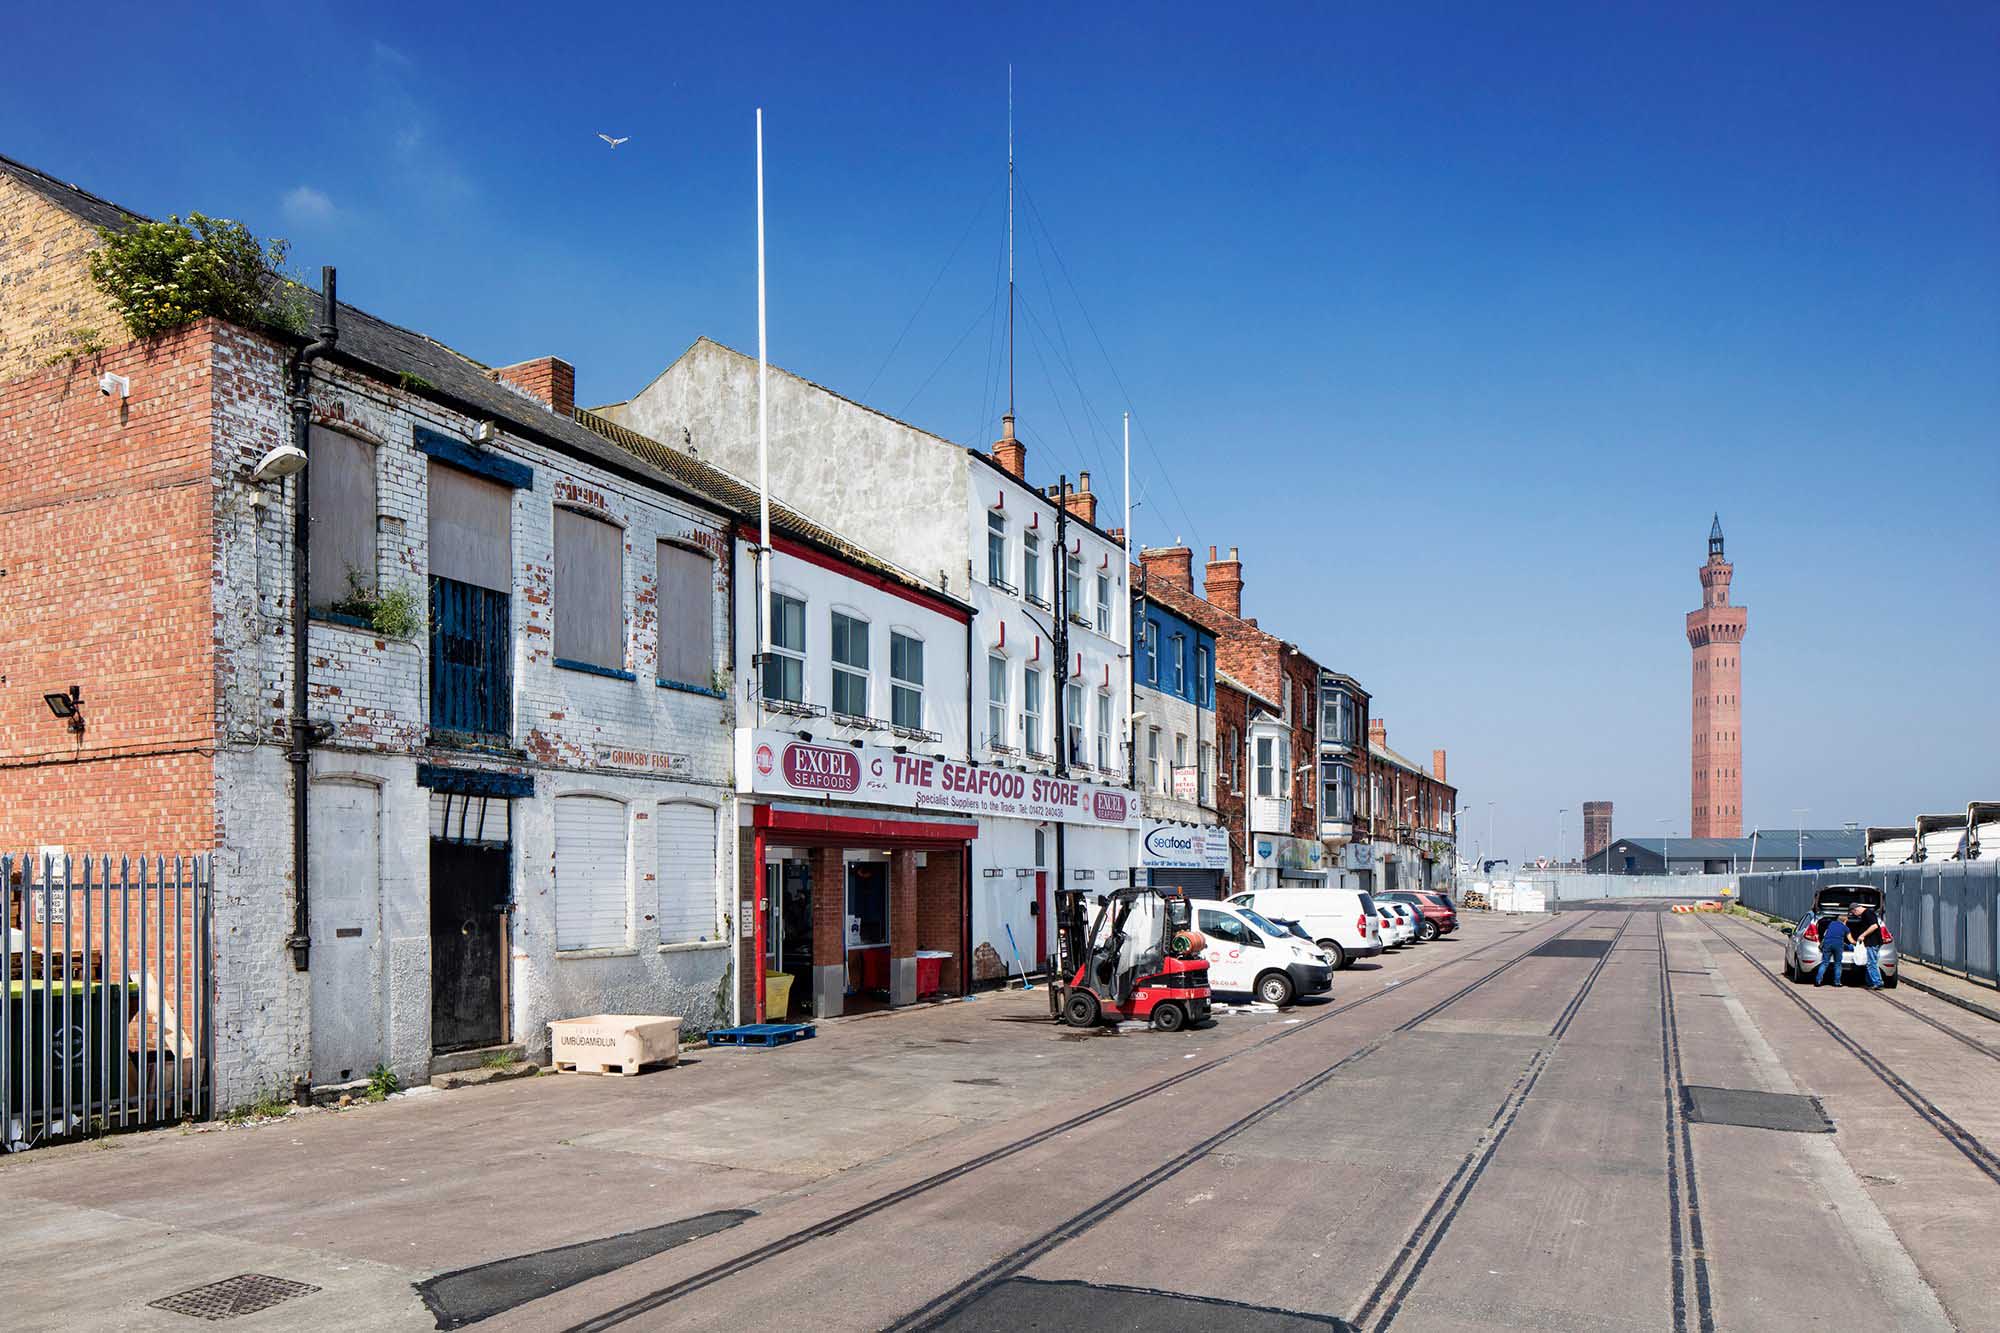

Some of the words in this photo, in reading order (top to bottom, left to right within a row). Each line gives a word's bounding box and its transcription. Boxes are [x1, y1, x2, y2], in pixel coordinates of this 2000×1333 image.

[612, 750, 649, 767] GRIMSBY
[652, 754, 670, 769] FISH
[794, 747, 851, 777] EXCEL
[794, 771, 852, 789] SEAFOODS
[893, 755, 933, 788] THE
[941, 763, 1025, 800] SEAFOOD
[1032, 778, 1079, 807] STORE
[916, 791, 949, 807] Specialist
[951, 796, 980, 811] Suppliers
[981, 801, 987, 810] to
[989, 800, 999, 812] the
[1000, 802, 1015, 813] Trade
[1029, 805, 1044, 817] 01472
[1097, 794, 1123, 812] EXCEL
[1097, 809, 1123, 820] SEAFOODS
[1153, 836, 1191, 849] seafood
